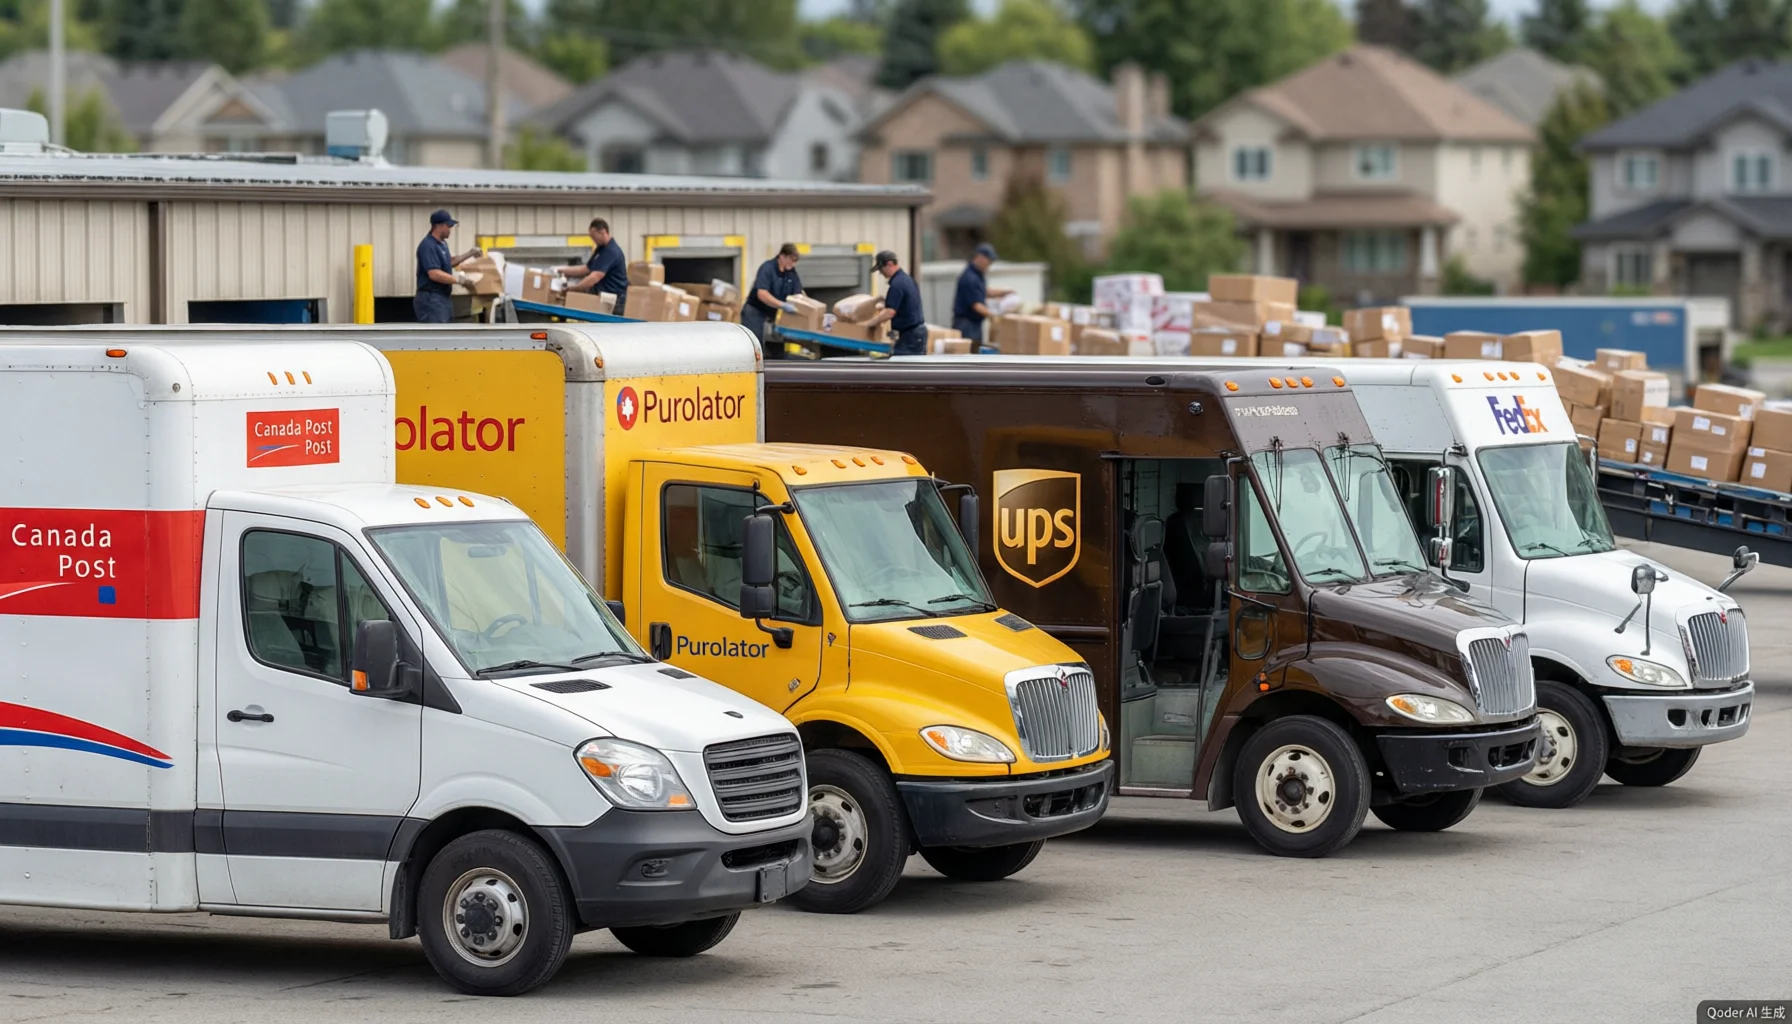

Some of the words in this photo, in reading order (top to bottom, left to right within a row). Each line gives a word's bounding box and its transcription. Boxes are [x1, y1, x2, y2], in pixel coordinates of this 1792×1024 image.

[644, 386, 746, 424] Purolator
[1486, 395, 1549, 435] FedEx
[254, 419, 302, 437] Canada
[305, 419, 333, 435] Post
[305, 439, 332, 455] Post
[11, 523, 111, 548] Canada
[1001, 507, 1075, 566] ups
[59, 554, 116, 578] Post
[677, 635, 769, 658] Purolator
